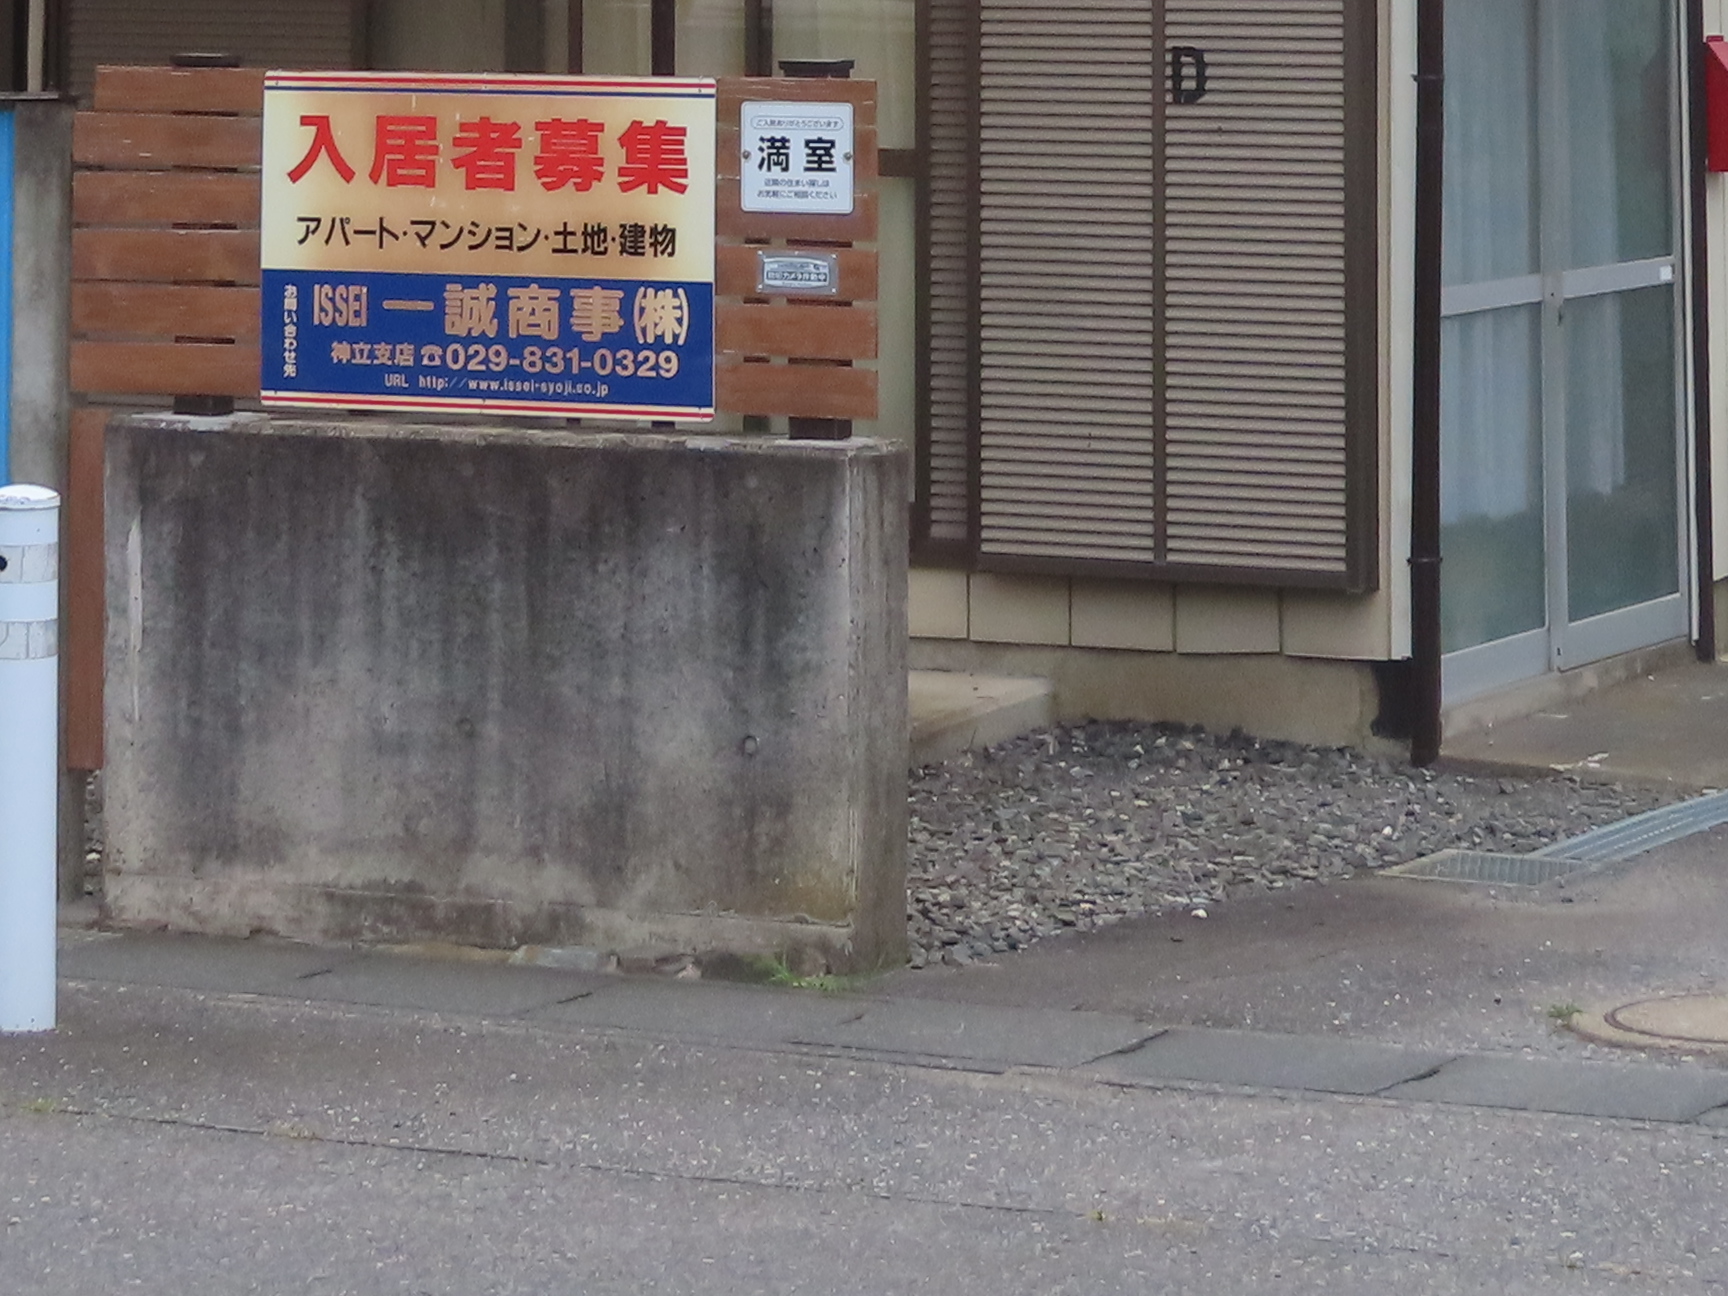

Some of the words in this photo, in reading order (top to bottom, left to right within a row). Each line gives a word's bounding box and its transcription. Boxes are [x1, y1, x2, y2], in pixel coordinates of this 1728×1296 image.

[1172, 46, 1206, 105] D
[286, 114, 690, 195] 入居者募集
[757, 135, 837, 173] 満室
[283, 284, 299, 379] お問い合わせ先
[330, 340, 416, 367] 神立支店
[445, 342, 680, 379] 029-831-0329
[384, 373, 410, 388] URL
